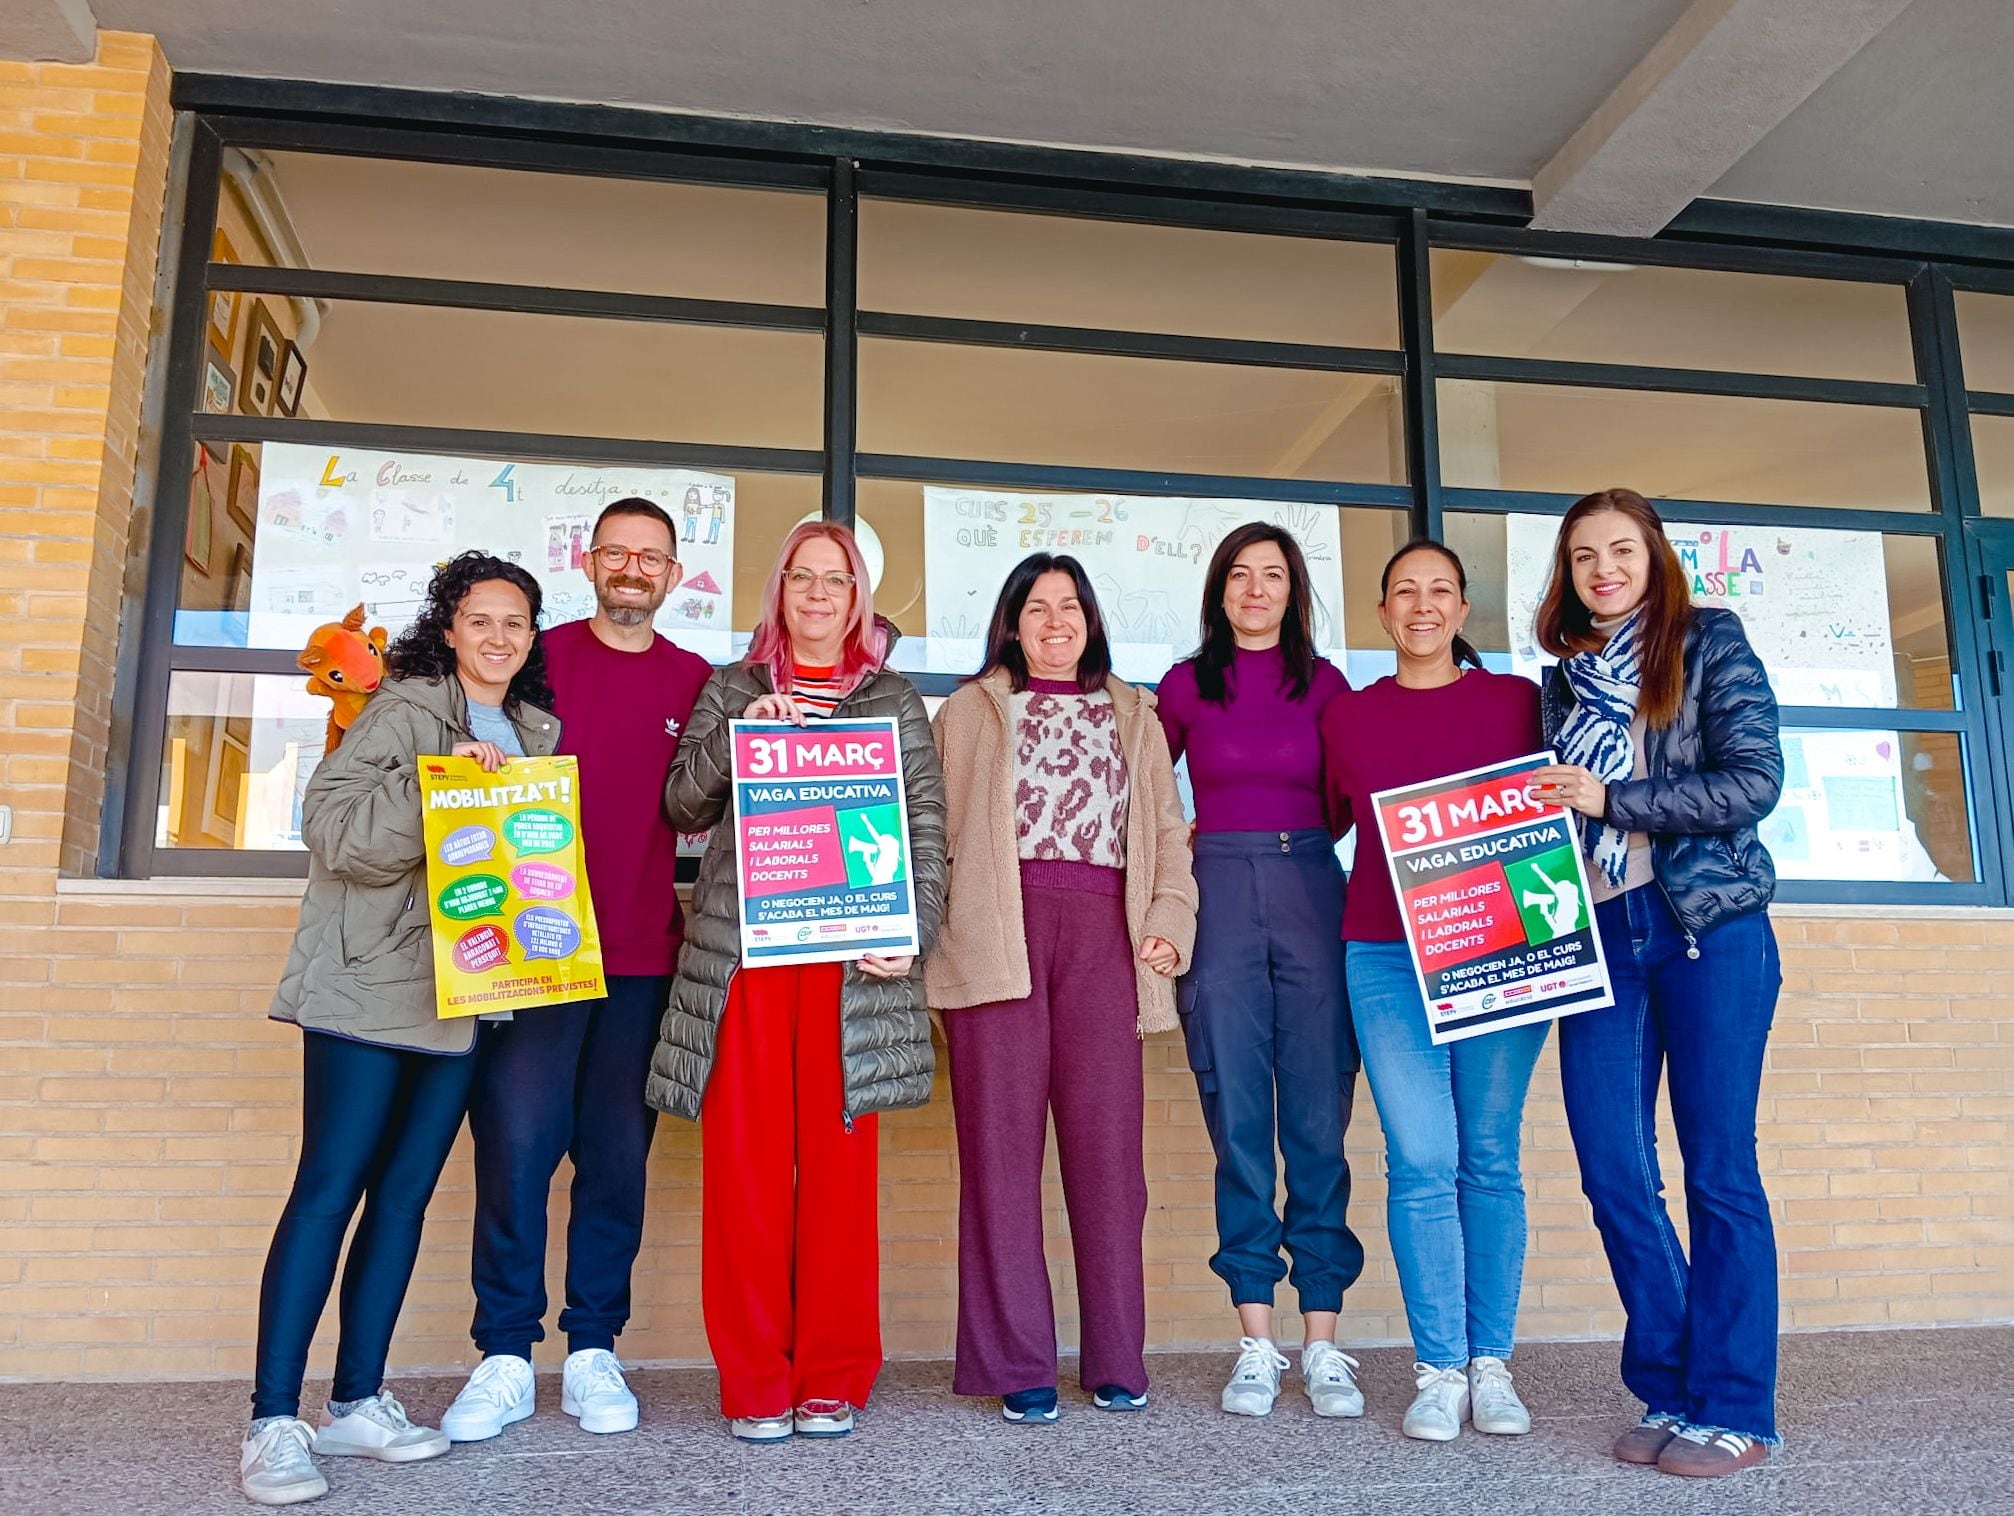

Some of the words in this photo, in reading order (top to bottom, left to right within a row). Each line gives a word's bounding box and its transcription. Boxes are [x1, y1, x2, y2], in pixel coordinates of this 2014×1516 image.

[320, 456, 357, 487] La
[376, 460, 432, 486] Classe
[450, 469, 469, 485] de
[555, 473, 622, 505] desitja
[955, 497, 1007, 522] CURS
[1018, 502, 1053, 527] 25
[1095, 498, 1129, 523] 26
[957, 525, 998, 547] QUÈ
[1020, 529, 1113, 548] ESPEREM
[1719, 530, 1763, 573] LA
[1692, 572, 1742, 597] ASSE
[749, 738, 788, 775] 31
[796, 742, 884, 771] MARÇ
[430, 776, 571, 810] MOBILITZA'T!
[749, 788, 796, 802] VAGA
[800, 784, 892, 801] EDUCATIVA
[1398, 800, 1444, 843] 31
[1448, 785, 1545, 828] MARÇ
[748, 826, 770, 837] PER
[773, 824, 831, 835] MILLORES
[749, 840, 814, 851] SALARIALS
[1407, 854, 1458, 873] VAGA
[1460, 827, 1561, 862] EDUCATIVA
[750, 856, 754, 866] I
[755, 854, 818, 866] LABORALS
[751, 870, 808, 882] DOCENTS
[761, 899, 770, 909] O
[772, 897, 826, 908] NEGOCIEN
[827, 896, 843, 907] JA,
[845, 895, 854, 904] O
[856, 894, 868, 903] EL
[870, 892, 897, 902] CURS
[1414, 896, 1438, 909] PER
[1439, 881, 1501, 901] MILLORES
[758, 910, 803, 921] S'ACABA
[806, 909, 818, 919] EL
[821, 907, 842, 917] MES
[845, 905, 858, 915] DE
[861, 903, 890, 914] MAIG!
[1418, 901, 1486, 925] SALARIALS
[1421, 929, 1426, 940] I
[1427, 916, 1494, 939] LABORALS
[1425, 934, 1485, 956] DOCENTS
[1442, 972, 1451, 982] O
[1452, 959, 1506, 980] NEGOCIEN
[1508, 955, 1525, 969] JA,
[1527, 952, 1536, 962] O
[1538, 948, 1552, 960] EL
[1553, 941, 1582, 956] CURS
[492, 976, 539, 989] PARTICIPA
[541, 976, 552, 984] EN
[1440, 979, 1486, 995] S'ACABA
[1488, 974, 1501, 985] EL
[1503, 968, 1526, 981] MES
[1527, 963, 1543, 975] DE
[1544, 955, 1576, 972] MAIG!
[447, 994, 466, 1006] LES
[468, 987, 544, 1003] MOBILITZACIONS
[546, 977, 598, 993] PREVISTES!
[1540, 982, 1557, 993] UGT
